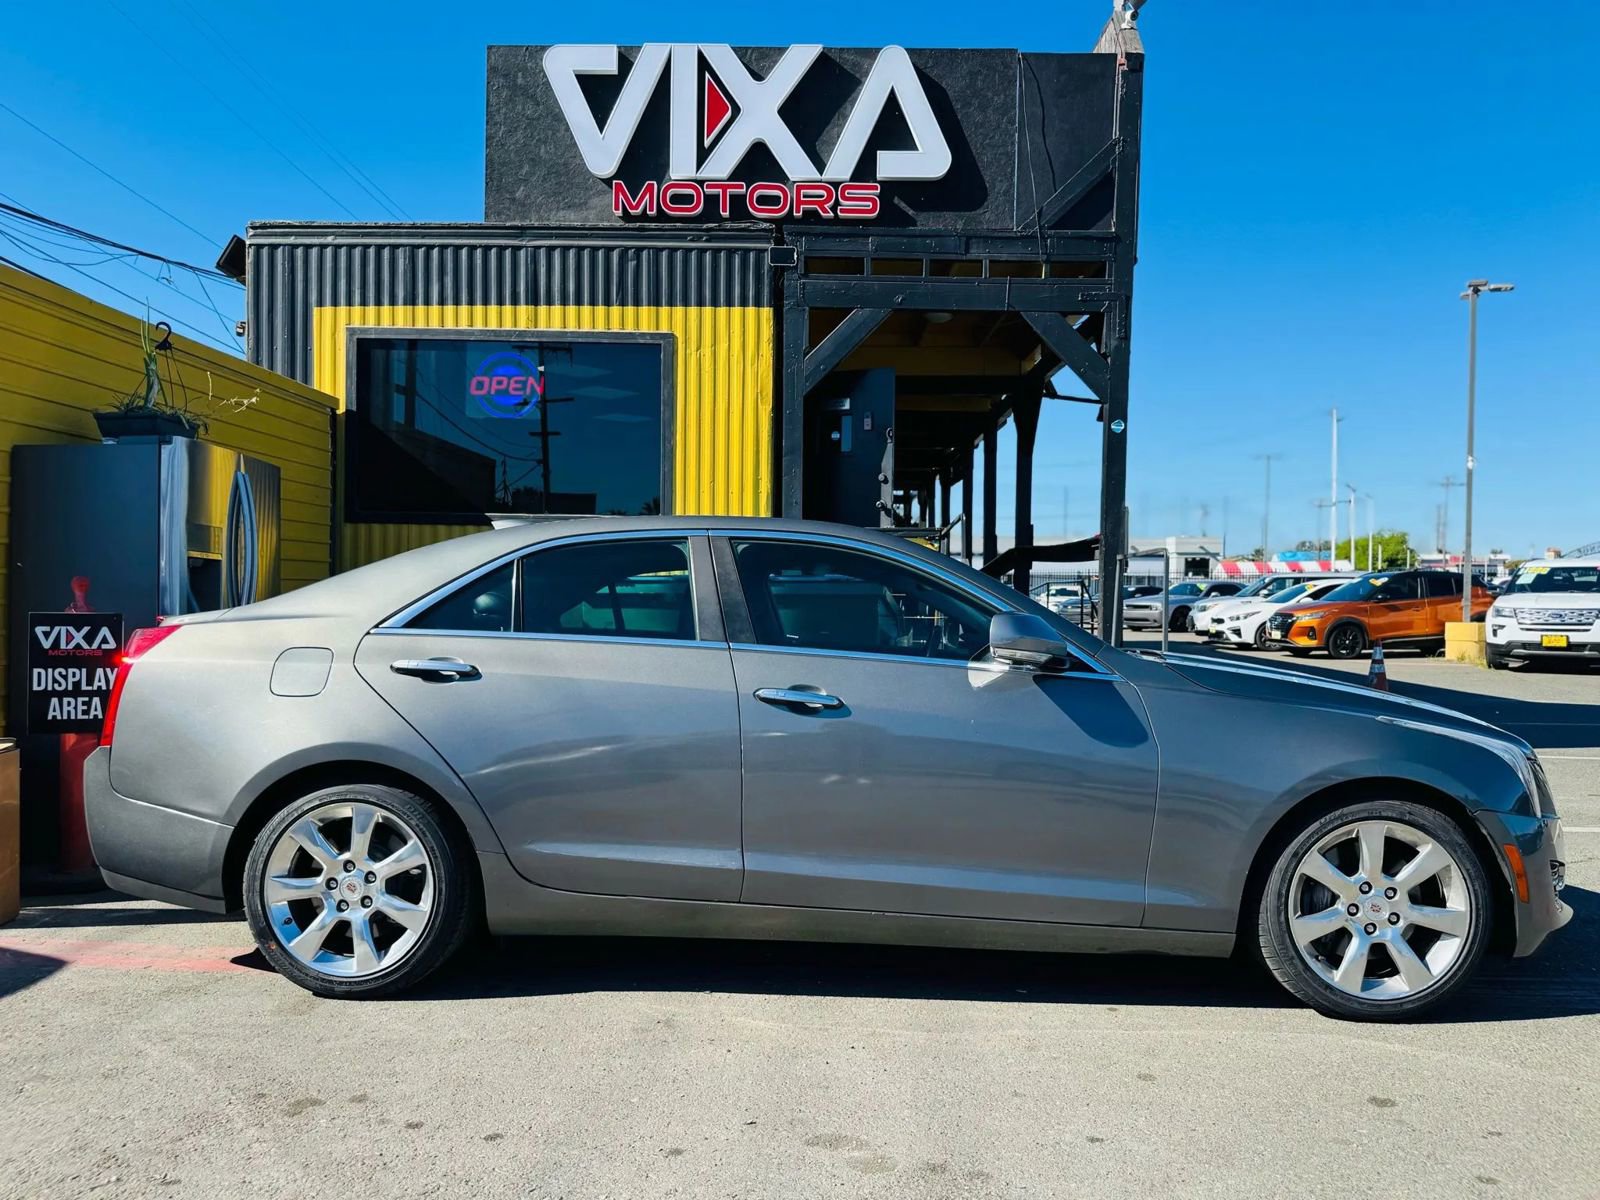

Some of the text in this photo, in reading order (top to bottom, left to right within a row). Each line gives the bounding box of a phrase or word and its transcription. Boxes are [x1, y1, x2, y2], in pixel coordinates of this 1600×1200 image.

[542, 43, 952, 180] VIXA
[611, 180, 881, 219] MOTORS
[469, 375, 545, 396] OPEN
[34, 626, 117, 649] VIXA
[33, 668, 118, 691] DISPLAY
[47, 697, 103, 720] AREA
